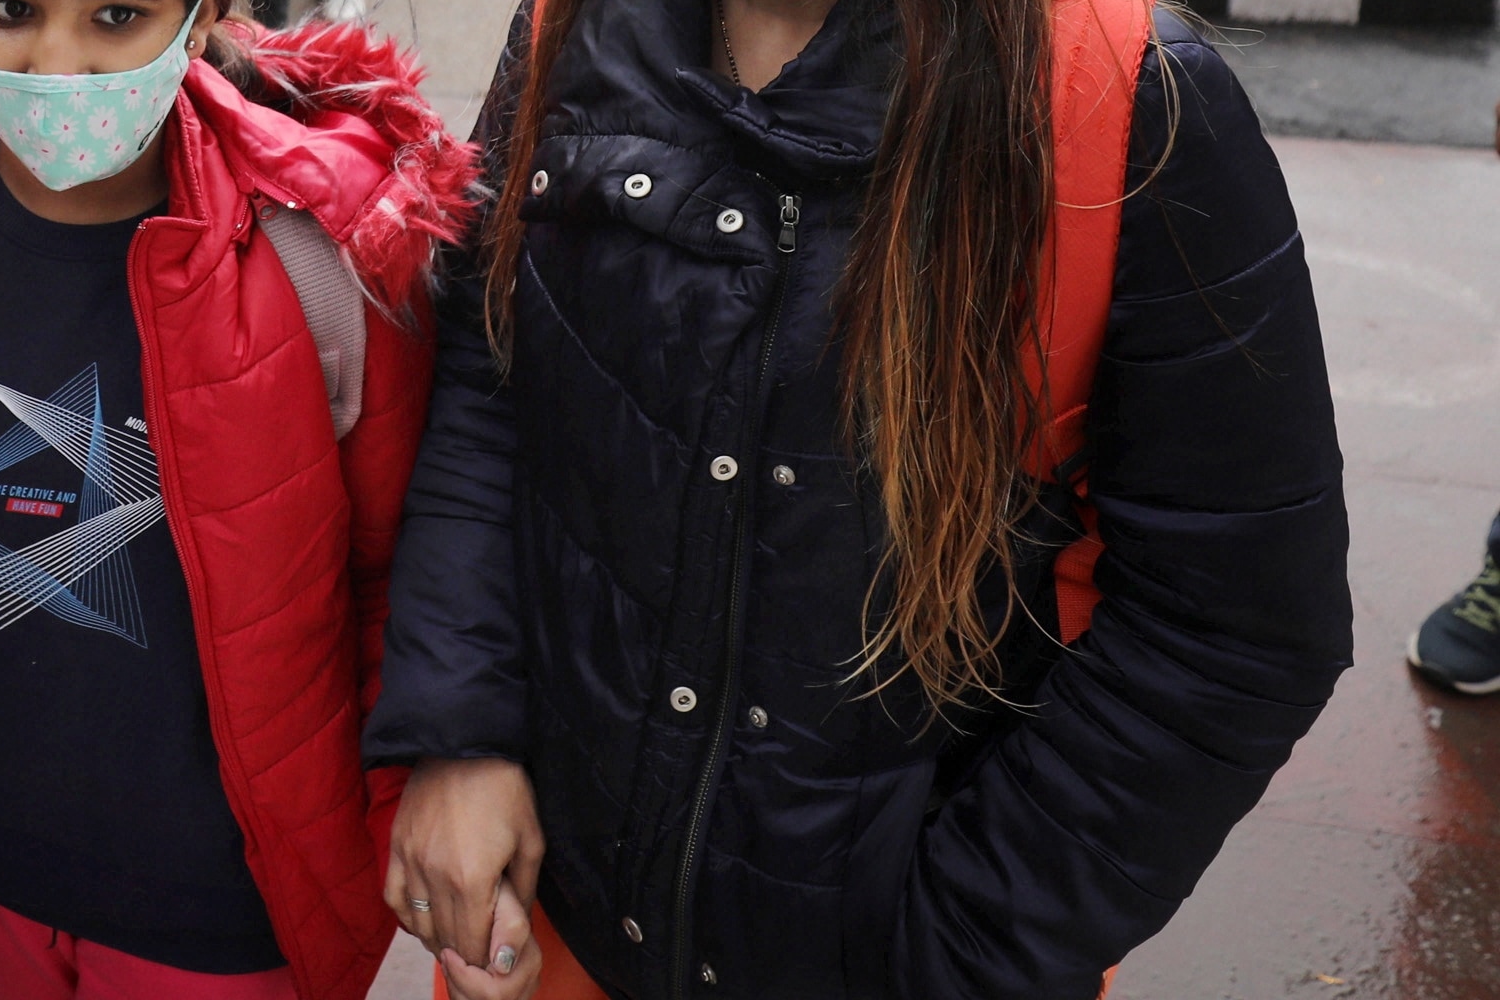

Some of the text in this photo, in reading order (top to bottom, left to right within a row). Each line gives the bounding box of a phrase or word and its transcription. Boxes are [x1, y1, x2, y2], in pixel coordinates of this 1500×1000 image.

[9, 485, 55, 500] CREATIVE
[56, 491, 77, 504] AND
[12, 500, 57, 515] HAVE FUN
